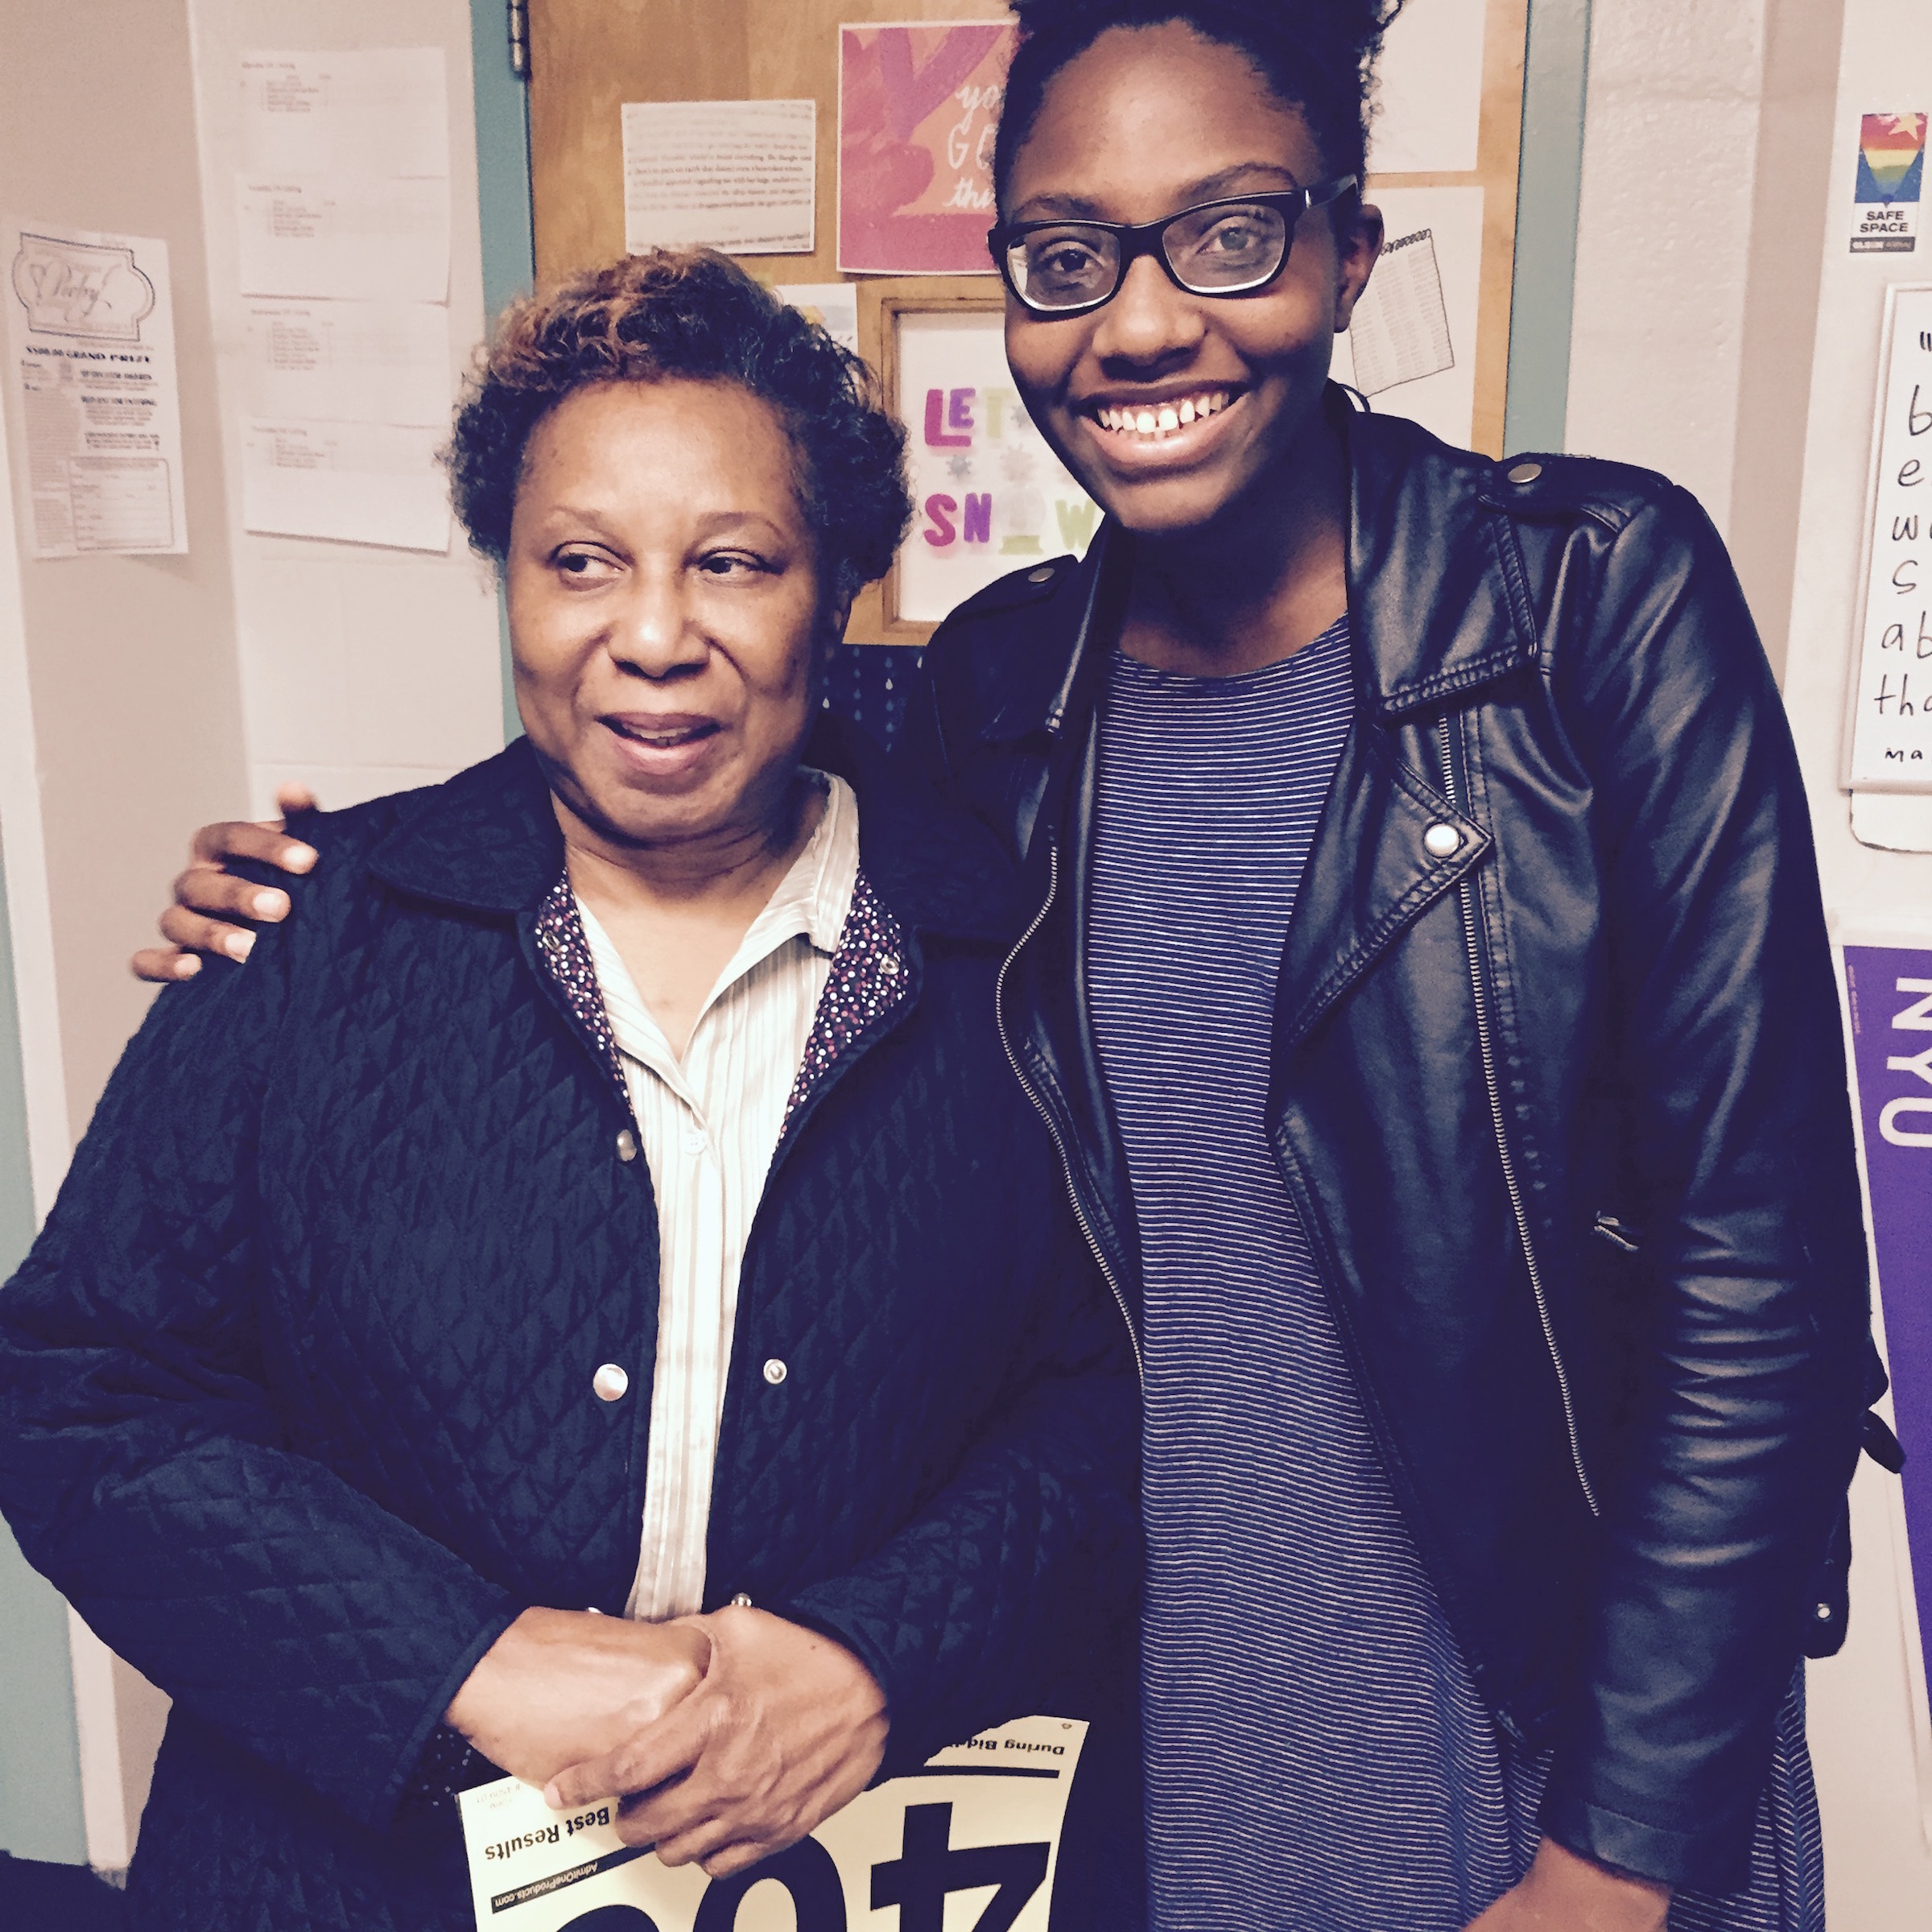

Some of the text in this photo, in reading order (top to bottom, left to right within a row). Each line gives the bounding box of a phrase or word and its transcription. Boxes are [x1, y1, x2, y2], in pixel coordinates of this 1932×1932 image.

[956, 84, 1005, 135] yo
[945, 176, 997, 208] thi
[1860, 221, 1909, 233] SPACE
[1866, 210, 1905, 221] SAFE
[66, 349, 105, 360] GRAND
[1897, 459, 1932, 487] e
[1892, 514, 1932, 541] w
[1879, 976, 1932, 1149] NYU
[952, 1738, 1066, 1756] During Bid
[484, 1806, 610, 1860] Best Results
[493, 1860, 599, 1908] AdmitOneProducts.com
